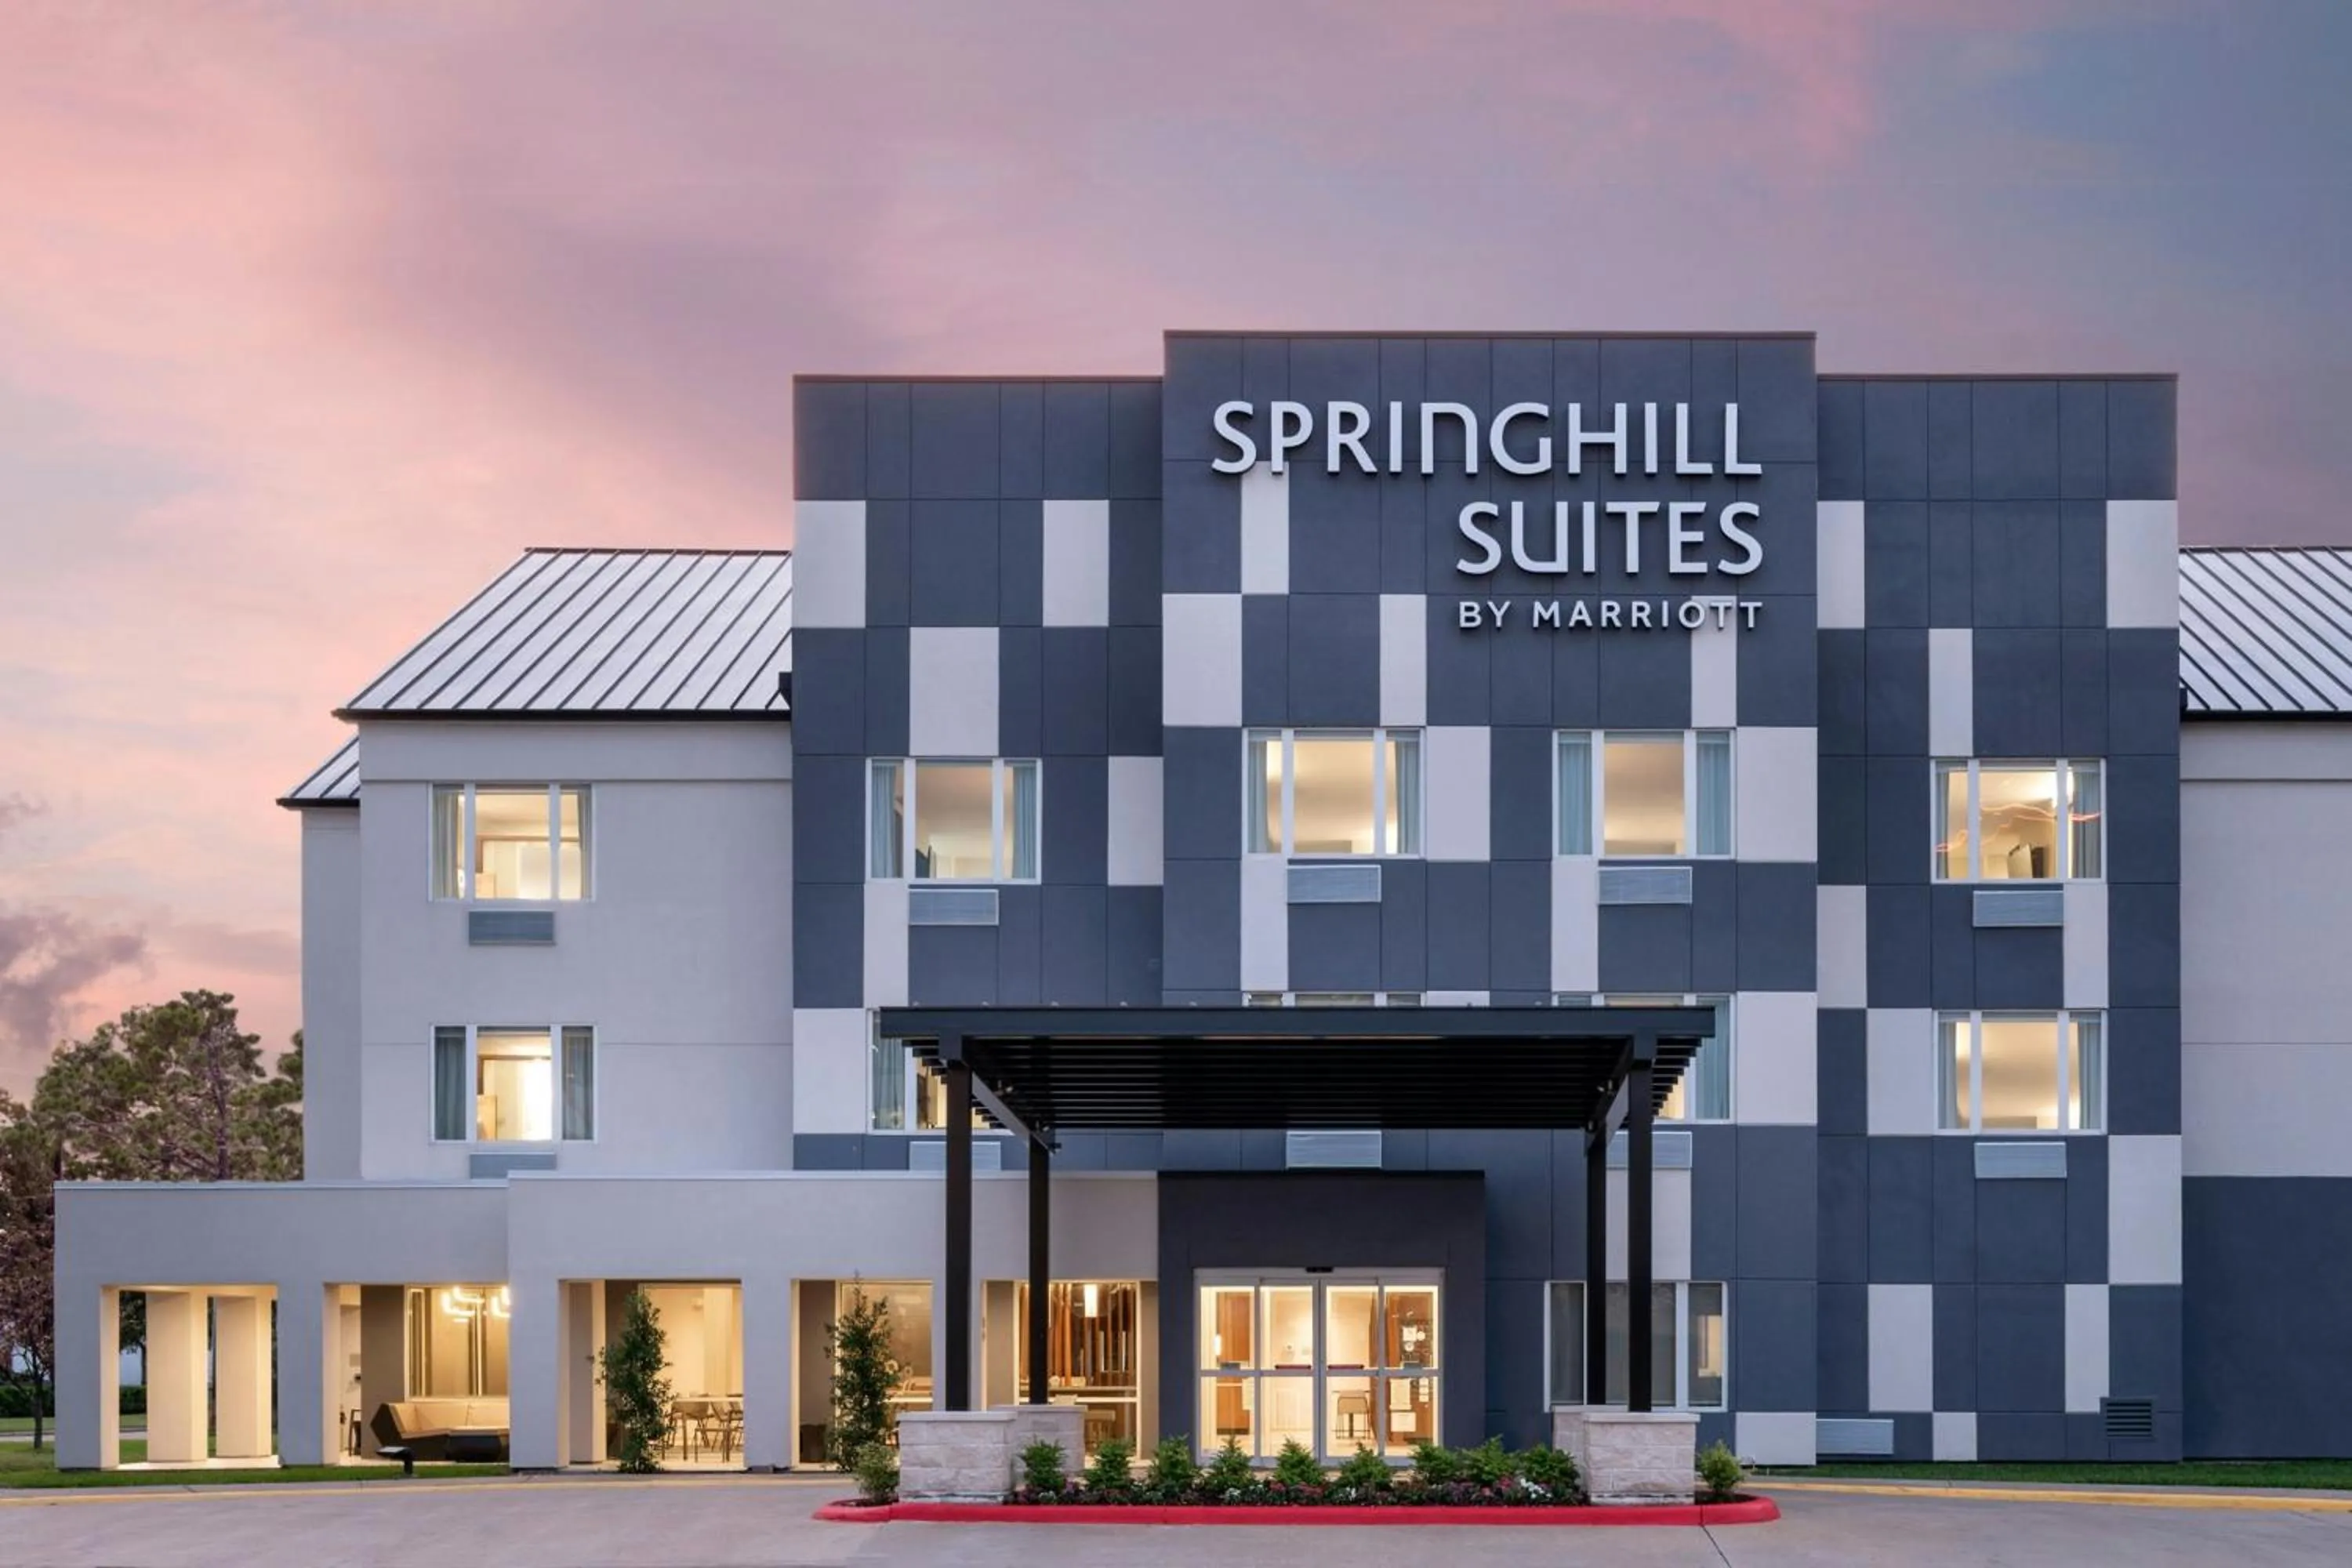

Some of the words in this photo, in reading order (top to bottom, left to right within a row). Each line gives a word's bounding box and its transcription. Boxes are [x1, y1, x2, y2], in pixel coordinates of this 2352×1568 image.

[1211, 400, 1763, 477] SPRINGHILL
[1456, 500, 1764, 575] SUITES
[1458, 601, 1512, 630] BY
[1533, 601, 1763, 630] MARRIOTT
